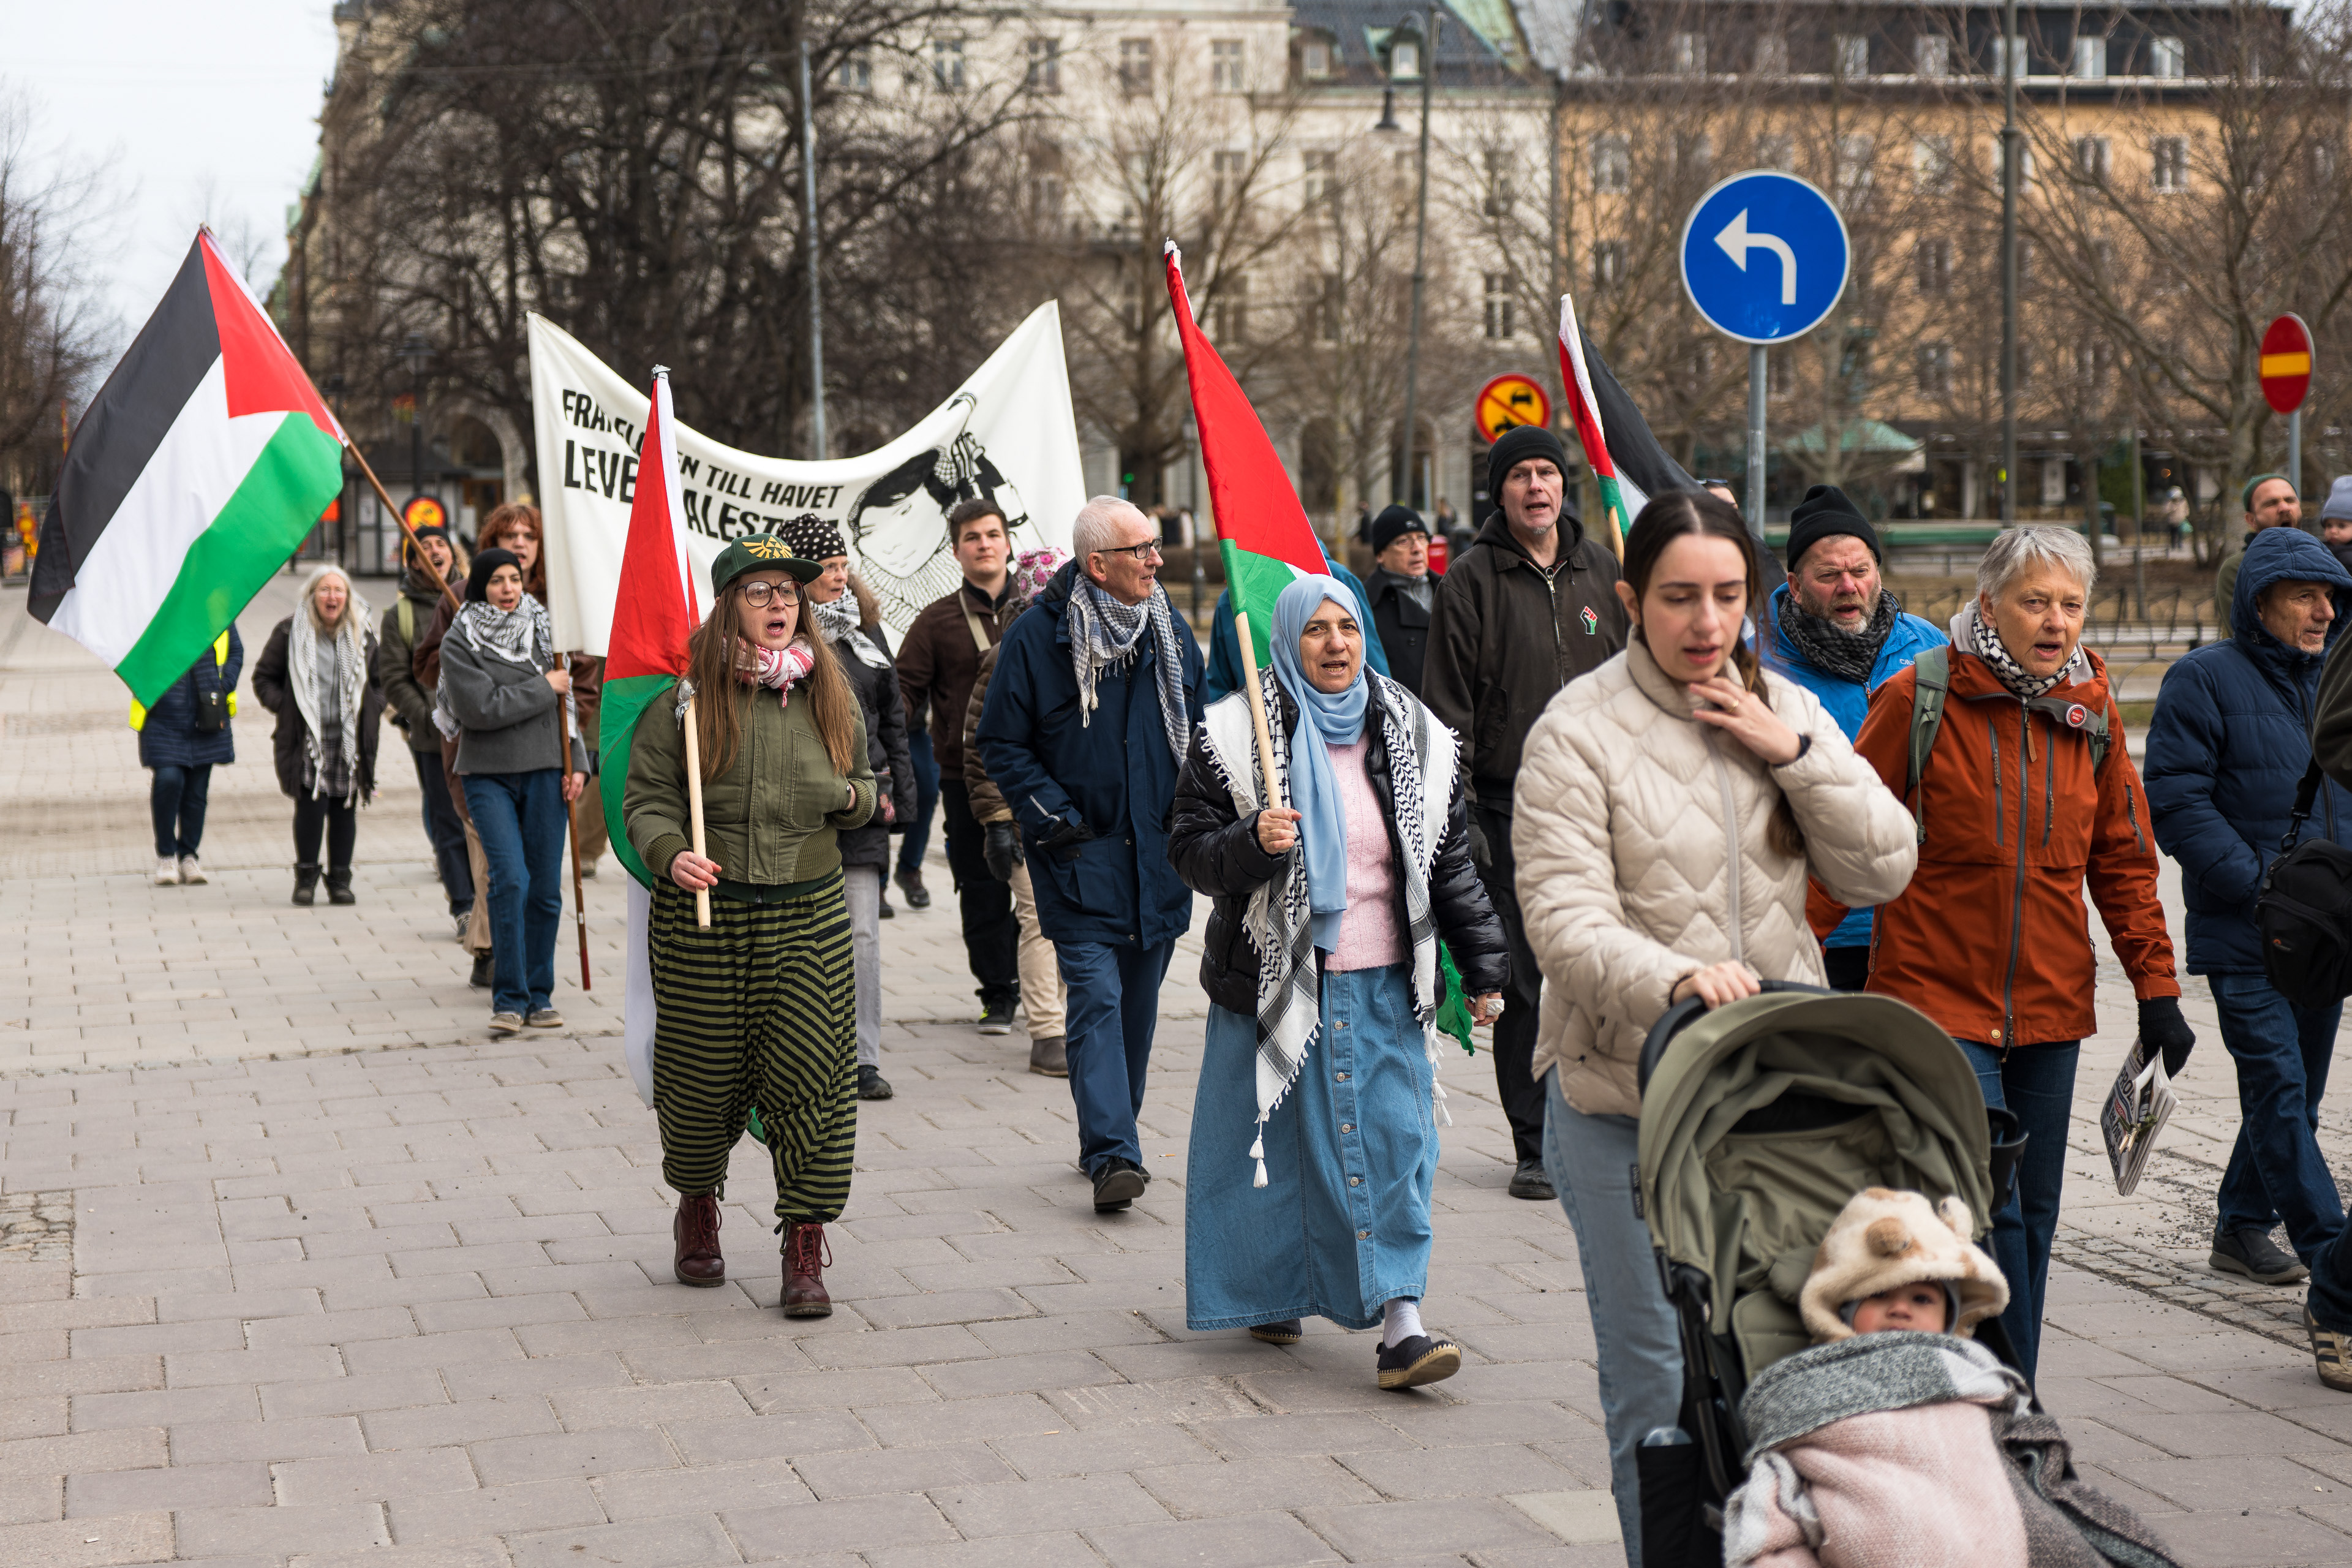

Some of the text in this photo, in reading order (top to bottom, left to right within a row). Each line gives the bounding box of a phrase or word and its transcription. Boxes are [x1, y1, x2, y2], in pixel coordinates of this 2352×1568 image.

[564, 439, 638, 503] LEVE
[707, 465, 752, 499] TILL
[760, 481, 844, 508] HAVET
